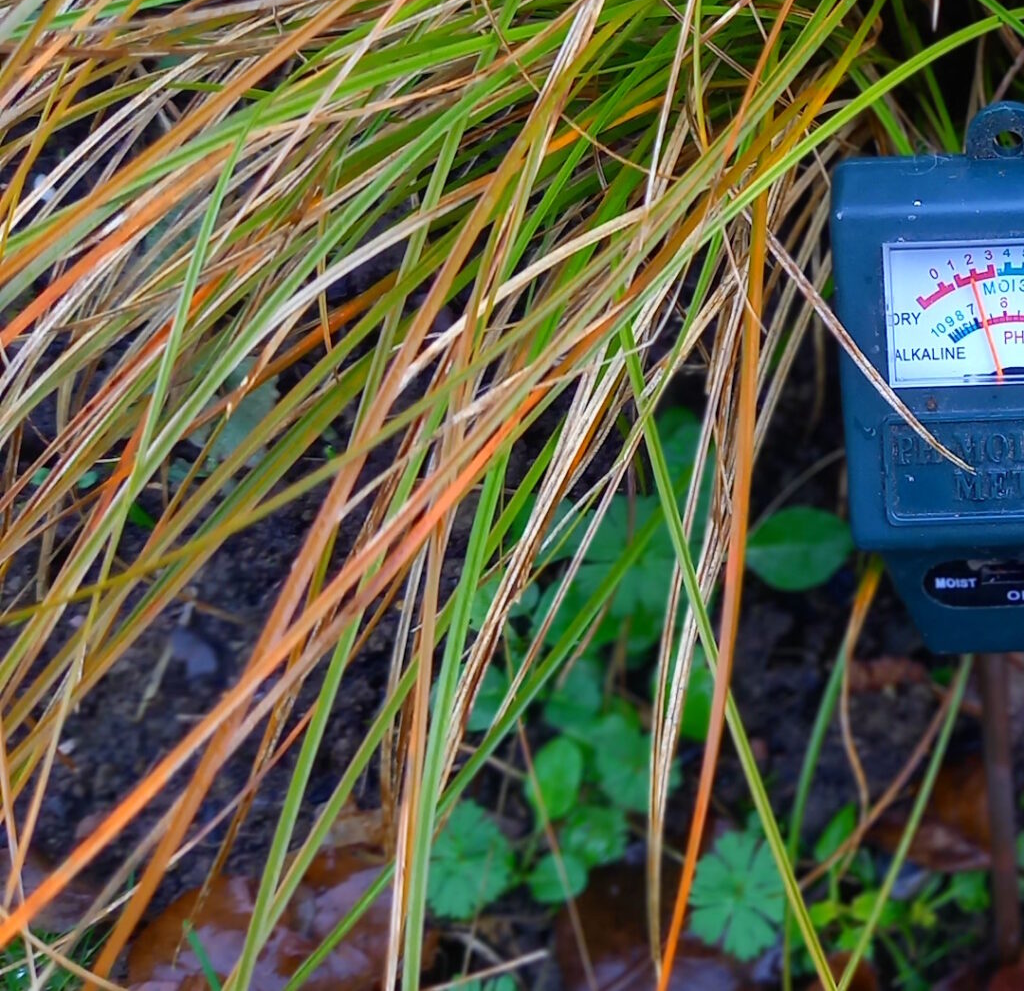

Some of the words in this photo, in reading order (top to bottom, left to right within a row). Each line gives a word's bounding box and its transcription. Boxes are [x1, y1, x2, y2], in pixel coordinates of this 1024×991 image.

[929, 268, 939, 280] 0
[947, 259, 955, 270] 1
[964, 253, 974, 265] 2
[984, 250, 993, 260] 3
[1003, 249, 1011, 258] 4
[893, 312, 922, 326] DRY
[931, 322, 947, 338] 10
[945, 315, 955, 327] 9
[955, 310, 965, 321] 8
[966, 303, 975, 315] 7
[1004, 330, 1024, 345] PH
[895, 346, 967, 361] ALKALINE
[934, 577, 977, 589] MOIST
